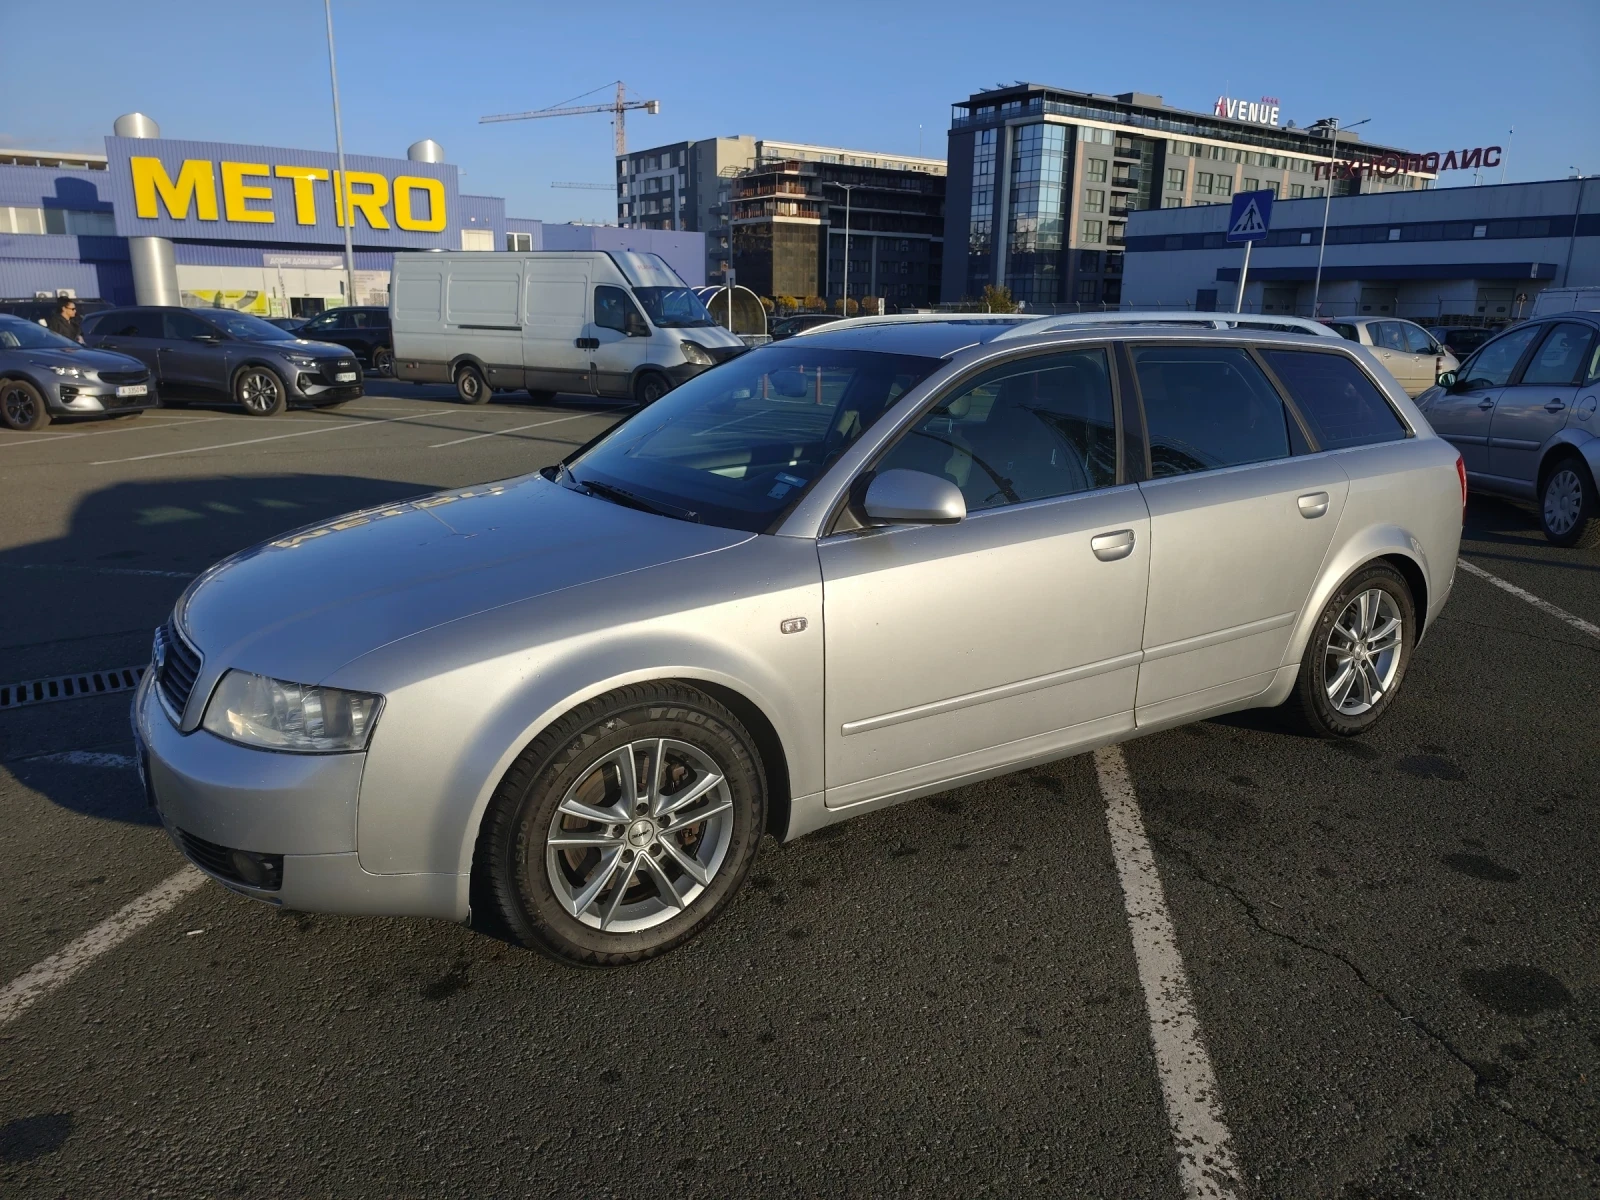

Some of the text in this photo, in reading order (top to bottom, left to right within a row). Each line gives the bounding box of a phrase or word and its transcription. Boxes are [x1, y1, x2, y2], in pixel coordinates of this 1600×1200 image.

[1214, 96, 1279, 126] AVENUE
[1312, 146, 1502, 181] ТЕХНОПОЛИС
[130, 156, 446, 233] METRO
